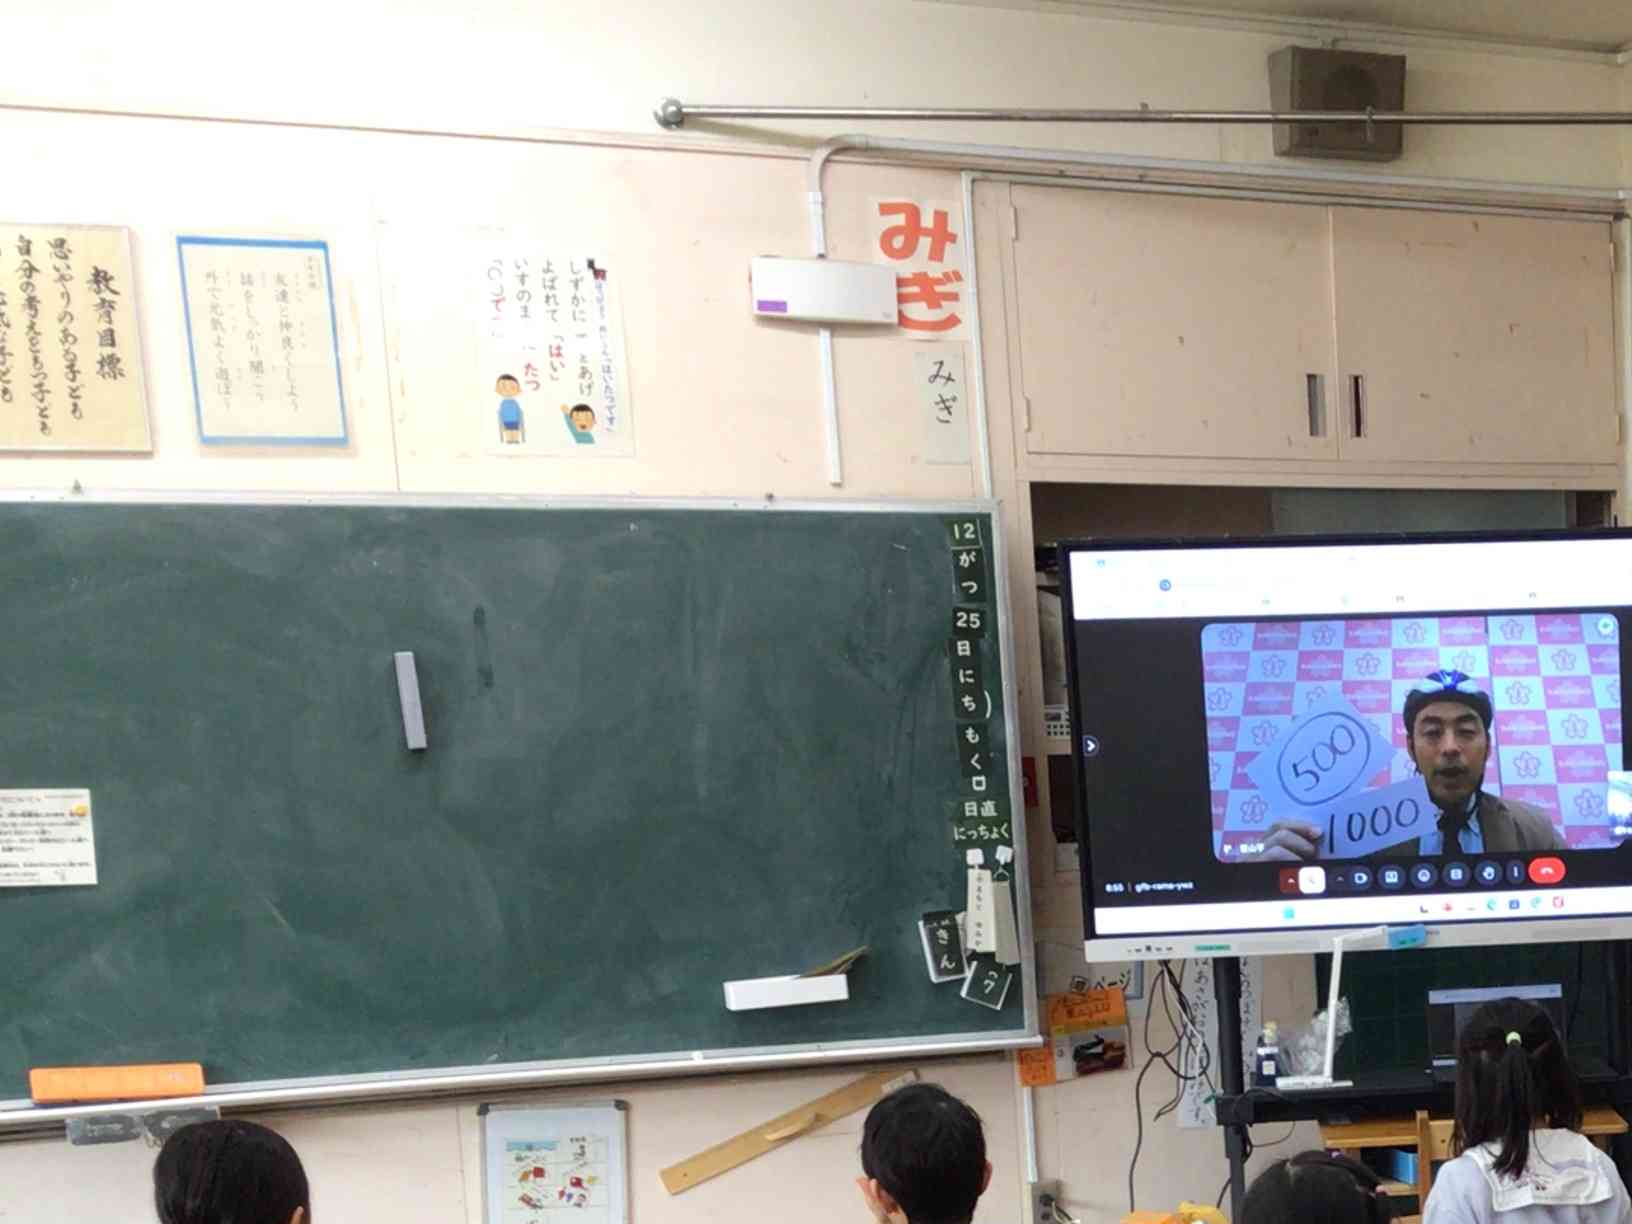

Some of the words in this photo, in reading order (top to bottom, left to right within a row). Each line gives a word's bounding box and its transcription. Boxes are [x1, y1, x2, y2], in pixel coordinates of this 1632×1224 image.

[877, 202, 962, 332] みぎ
[85, 265, 126, 381] 教育目標
[928, 361, 957, 424] みぎ
[1292, 724, 1356, 791] 500
[954, 822, 1009, 841] にっちょく
[964, 801, 998, 818] 日直
[1328, 798, 1419, 854] 1000
